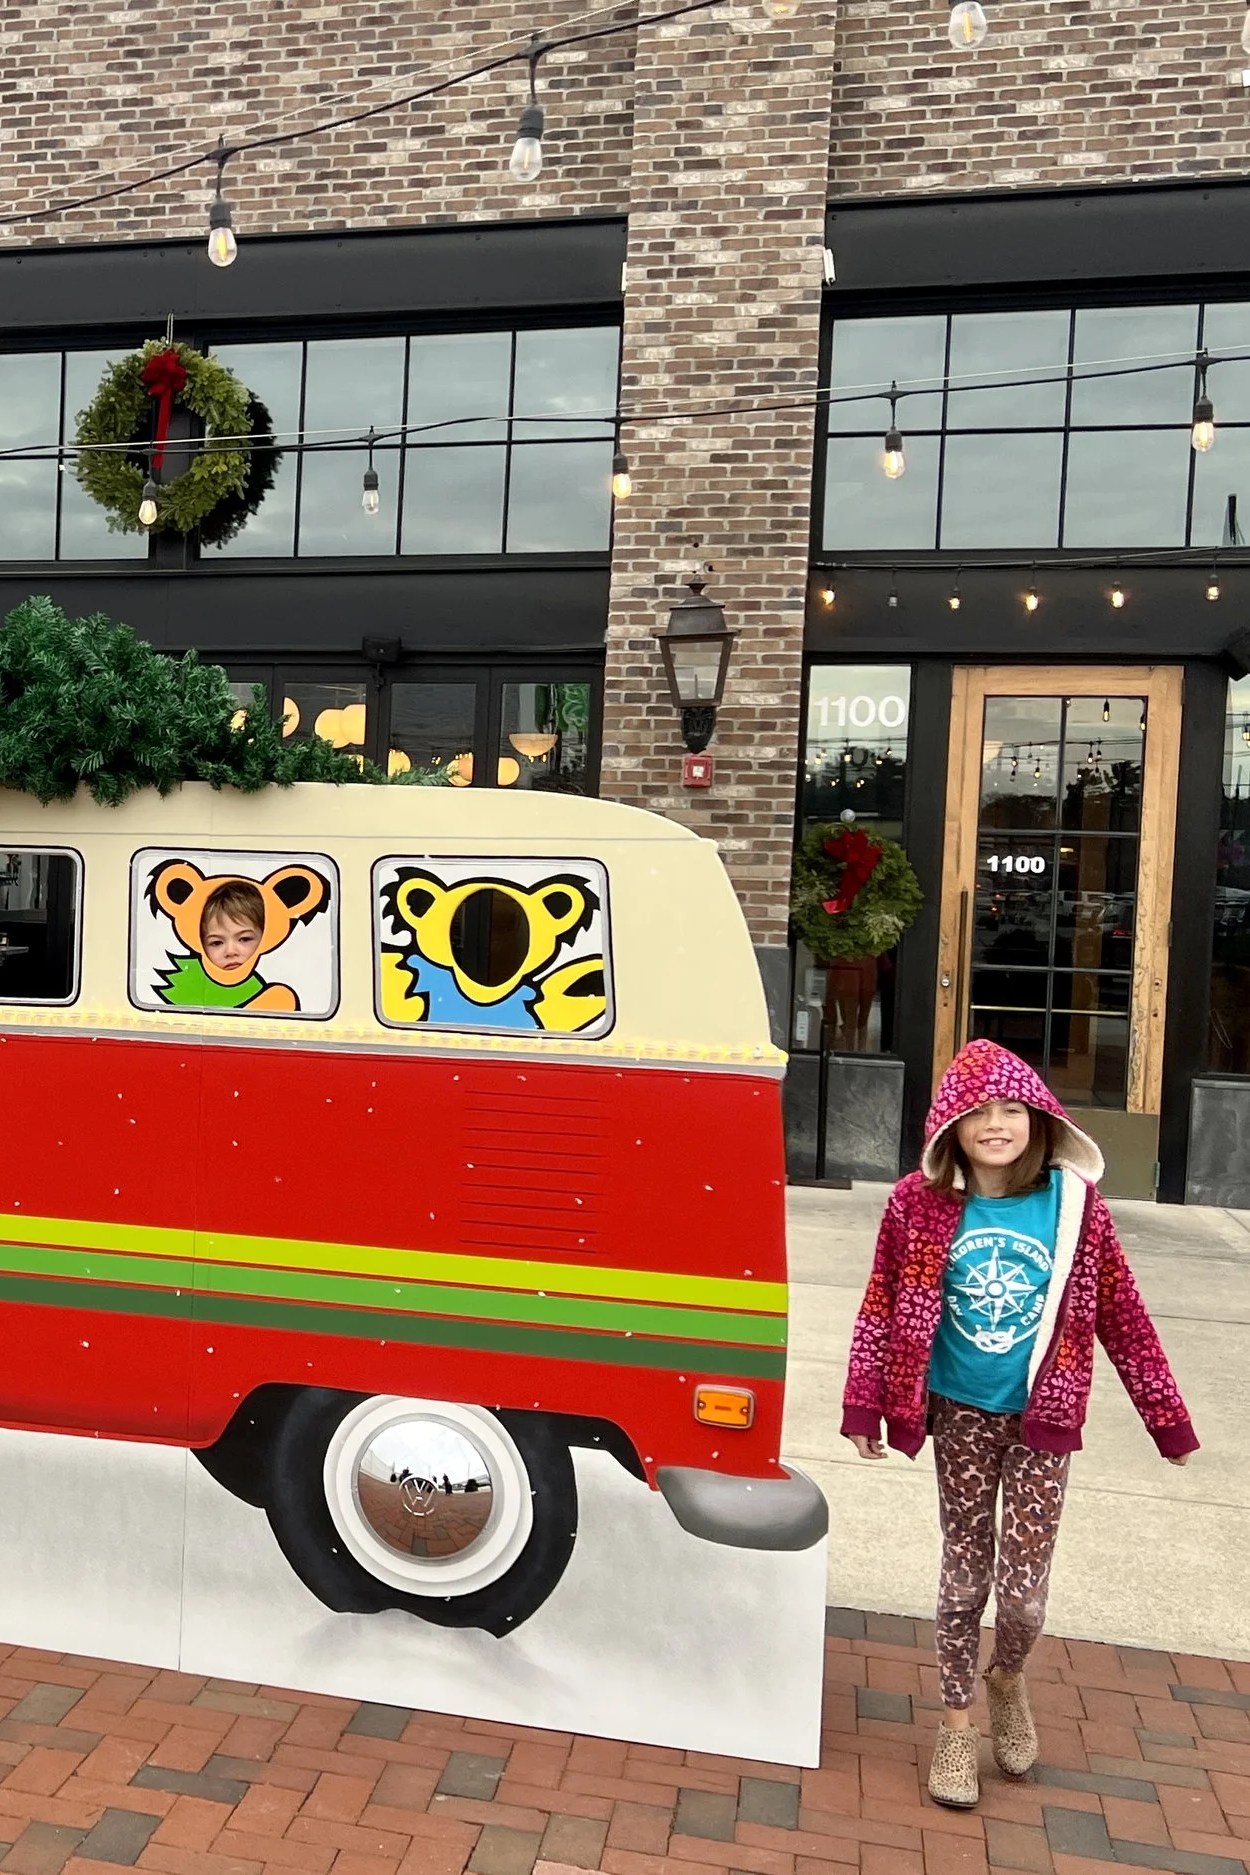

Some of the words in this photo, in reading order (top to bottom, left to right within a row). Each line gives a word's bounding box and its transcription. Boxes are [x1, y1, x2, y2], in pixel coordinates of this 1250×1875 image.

[814, 695, 906, 728] 1100
[986, 855, 1046, 873] 1100
[946, 1236, 1007, 1271] CILDREN'S
[1012, 1240, 1050, 1272] ISLAND
[947, 1295, 964, 1316] DAY
[1020, 1294, 1045, 1326] CAMP
